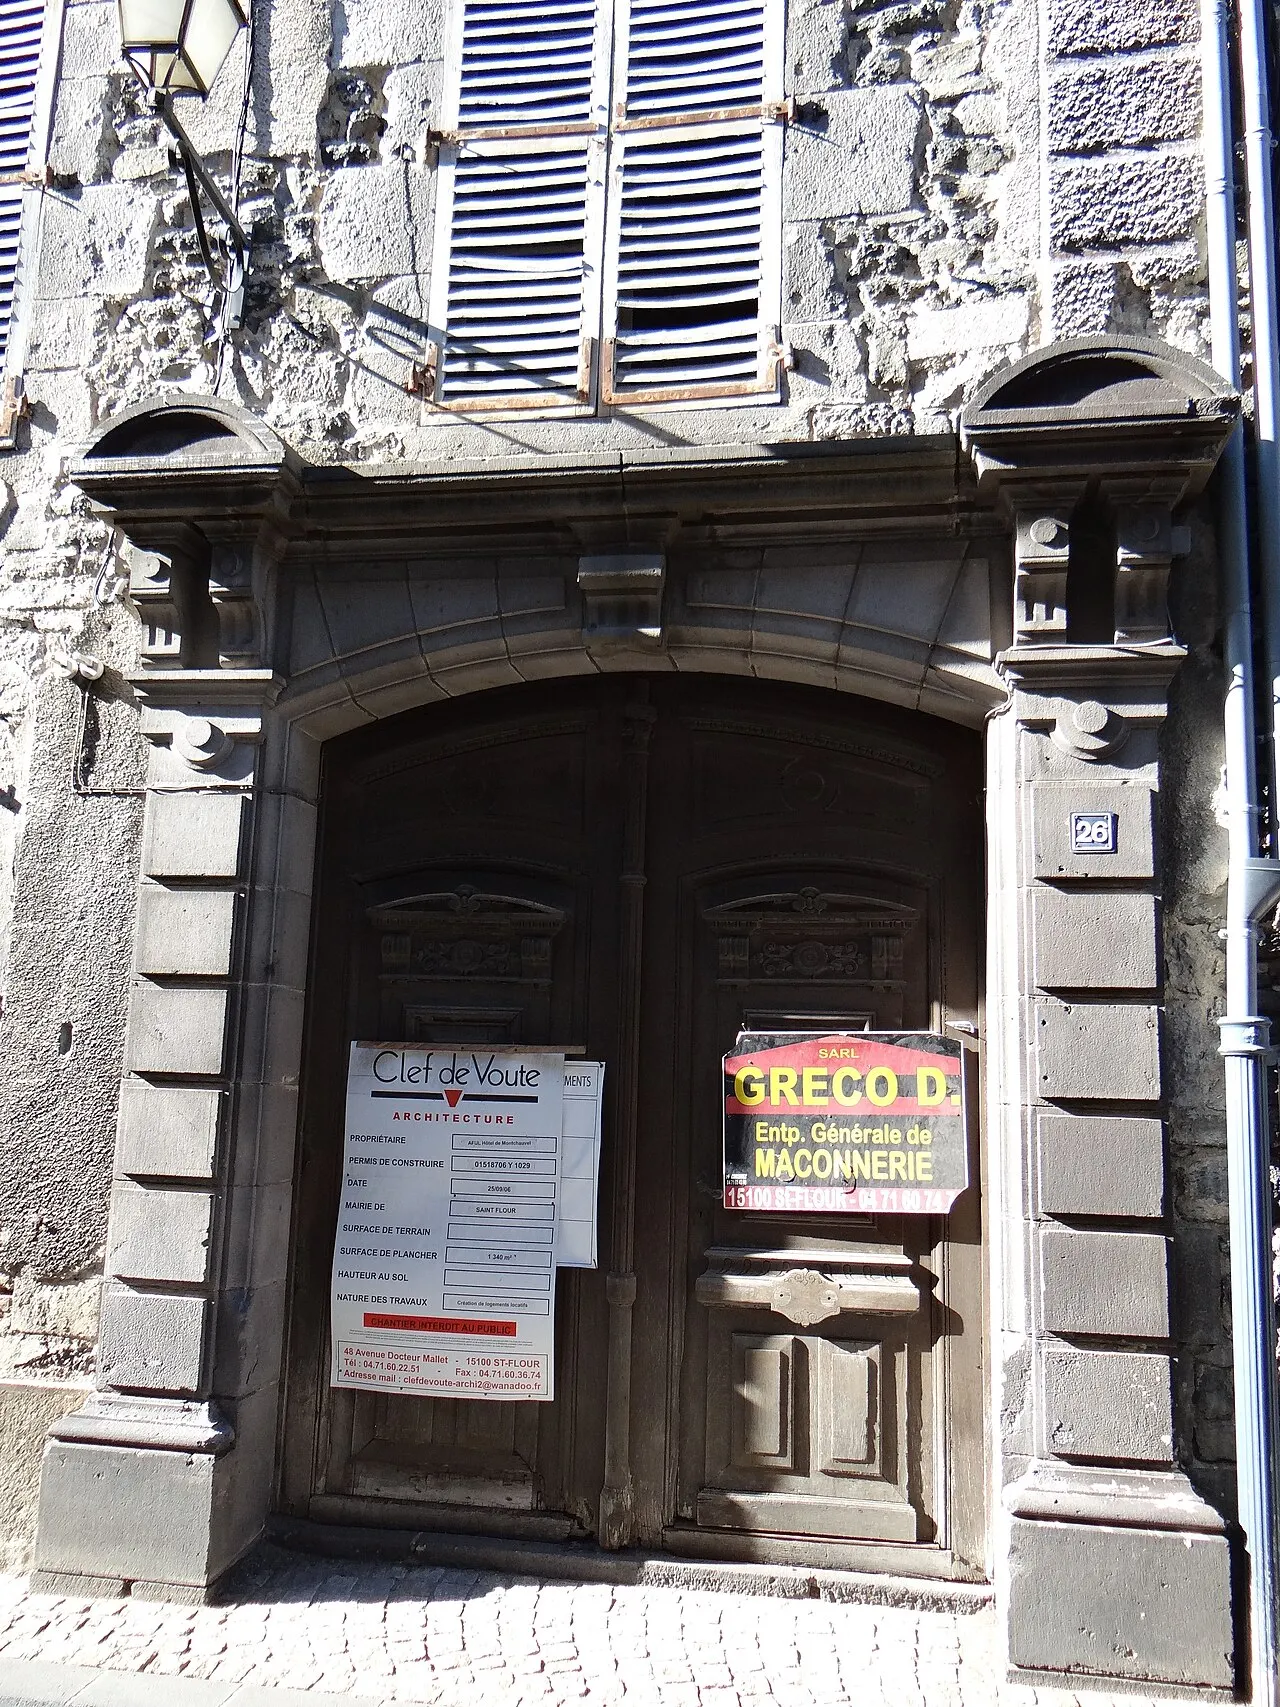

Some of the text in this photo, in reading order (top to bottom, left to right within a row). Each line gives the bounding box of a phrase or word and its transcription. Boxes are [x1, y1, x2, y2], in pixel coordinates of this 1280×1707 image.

[1075, 820, 1108, 843] 26
[818, 1048, 860, 1059] SARL
[373, 1050, 541, 1087] Clef de Voute
[734, 1065, 961, 1107] GRECO D.
[393, 1111, 515, 1125] ARCHITECTURE
[350, 1133, 406, 1144] PROPRIÉTAIRE
[755, 1121, 932, 1147] Entp. Générale de
[349, 1156, 444, 1168] PERMIS DE CONSTRUIRE
[474, 1160, 507, 1169] 01518706
[508, 1161, 513, 1169] Y
[755, 1147, 934, 1181] MACONNERIE
[347, 1179, 368, 1187] DATE
[728, 1187, 771, 1208] 15100
[345, 1201, 385, 1211] MAIRIE DE
[342, 1224, 431, 1236] SURFACE DE TERRAIN
[340, 1247, 437, 1260] SURFACE DE PLANCHER
[337, 1270, 408, 1281] HAUTEUR AU SOL
[336, 1293, 427, 1306] NATURE DES TRAVAUX
[370, 1318, 512, 1335] CHANTIER INTERDIT AU PUBLIC
[343, 1347, 354, 1356] 48
[355, 1349, 386, 1359] Avenue
[387, 1351, 421, 1362] Docteur
[422, 1354, 449, 1364] Mallet
[466, 1357, 491, 1366] 15100
[493, 1359, 540, 1368] ST-FLOUR
[343, 1358, 356, 1367] Tél
[363, 1360, 420, 1373] 04.71.60.22.51
[455, 1368, 471, 1377] Fax
[479, 1369, 541, 1379] 04.71.60.36.74
[343, 1369, 377, 1381] Adresse
[379, 1374, 396, 1382] mail
[403, 1376, 542, 1391] clefdevoute-archi2@wanadoo.fr
